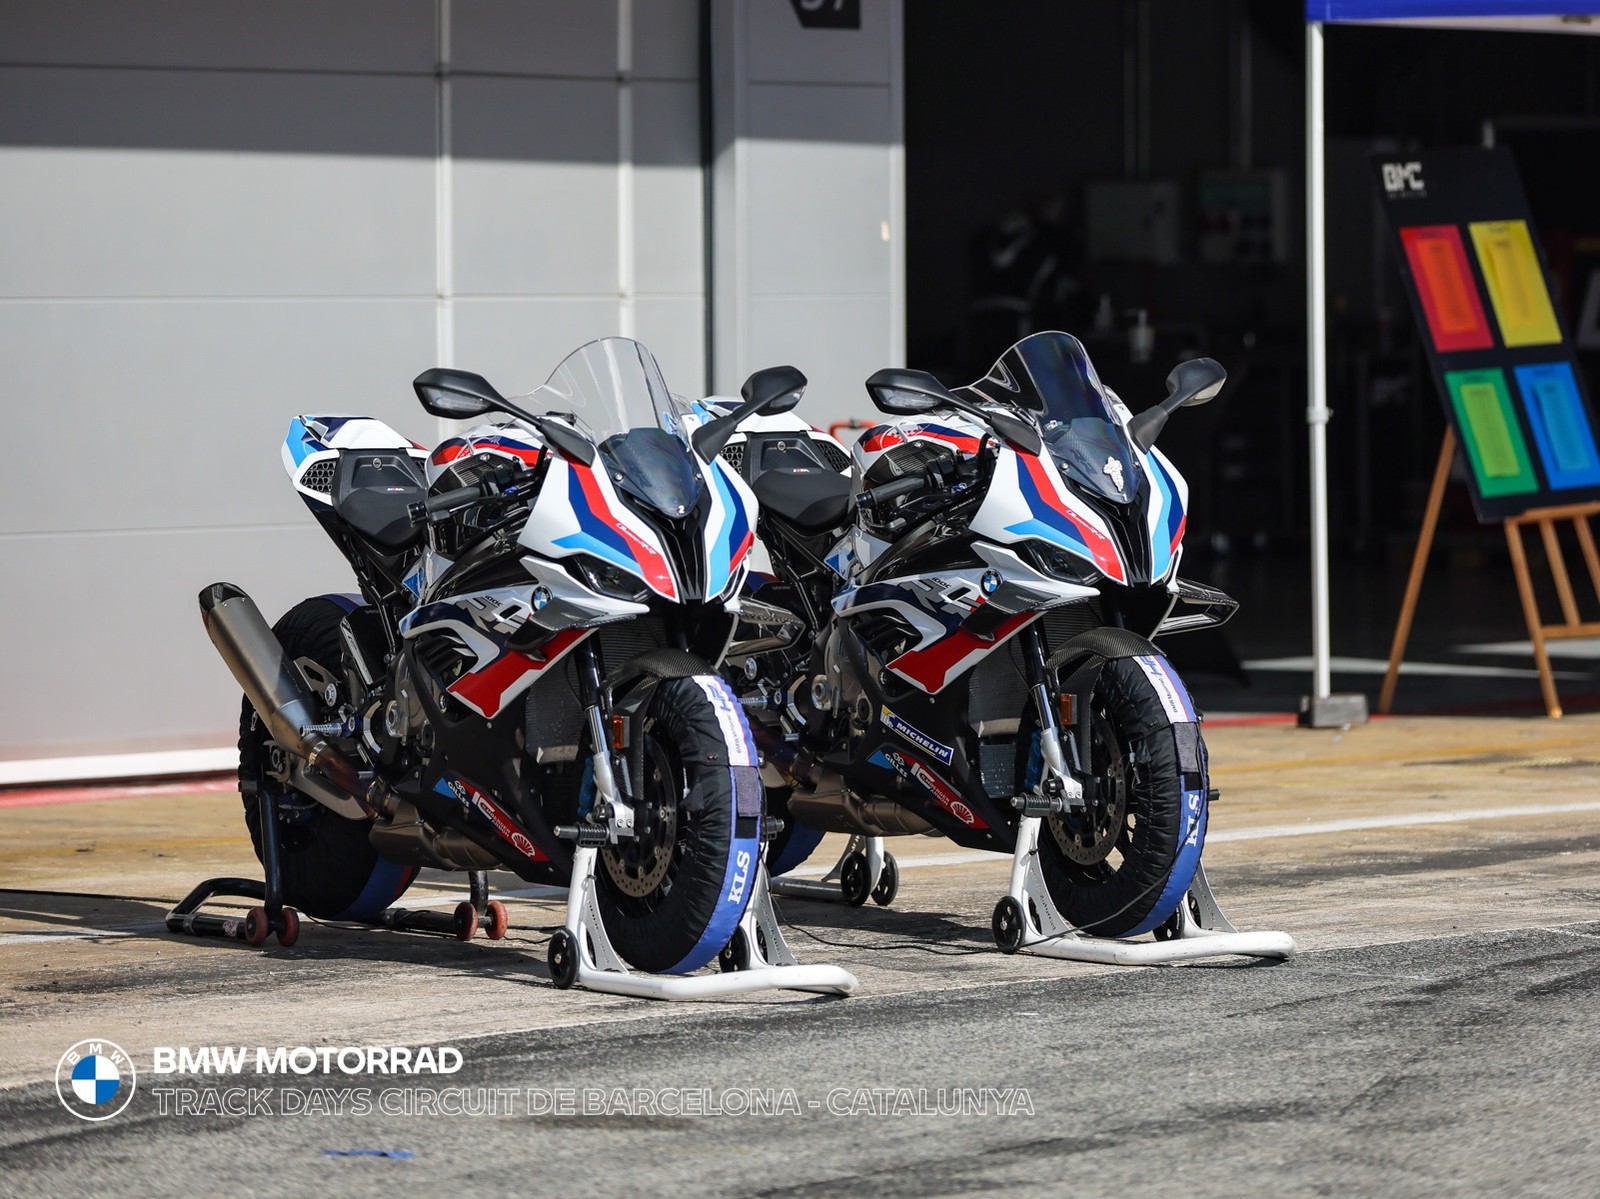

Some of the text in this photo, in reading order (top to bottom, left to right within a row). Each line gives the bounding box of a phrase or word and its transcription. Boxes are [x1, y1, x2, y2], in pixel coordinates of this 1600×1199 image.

[677, 504, 685, 514] 2
[896, 722, 949, 758] MICHELIN
[885, 753, 909, 779] GILLES
[447, 781, 470, 808] GILLES
[728, 850, 751, 905] KLS
